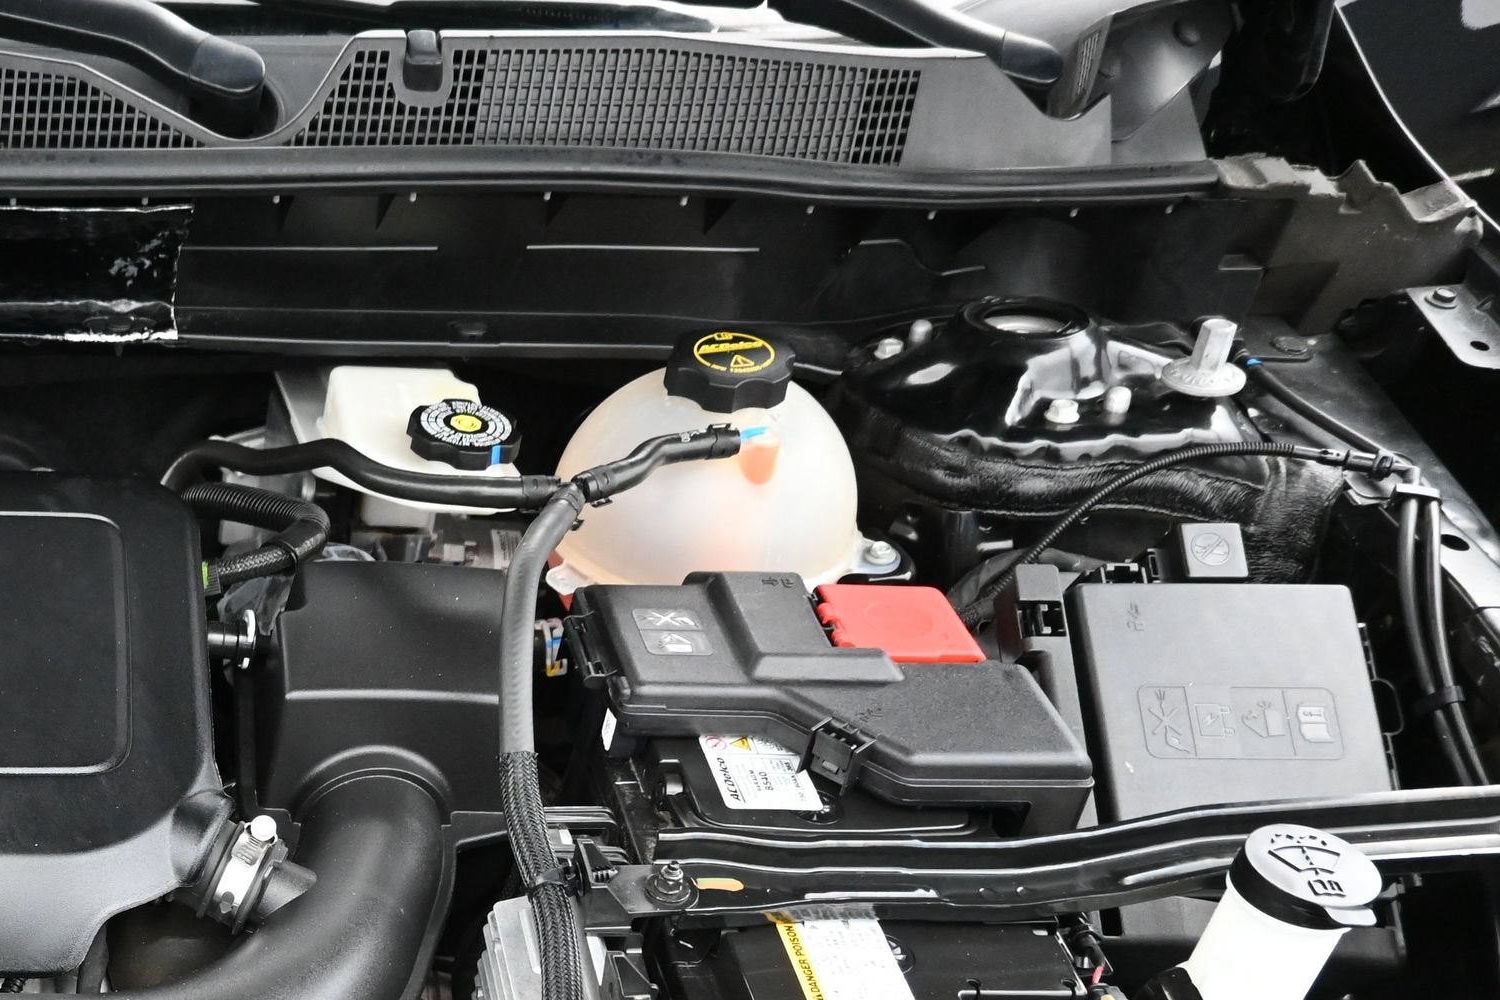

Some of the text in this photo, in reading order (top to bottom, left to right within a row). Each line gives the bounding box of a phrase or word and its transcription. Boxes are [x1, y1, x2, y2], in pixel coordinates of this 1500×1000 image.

[717, 757, 741, 801] ACDelco
[785, 925, 820, 994] DANGER POISON
